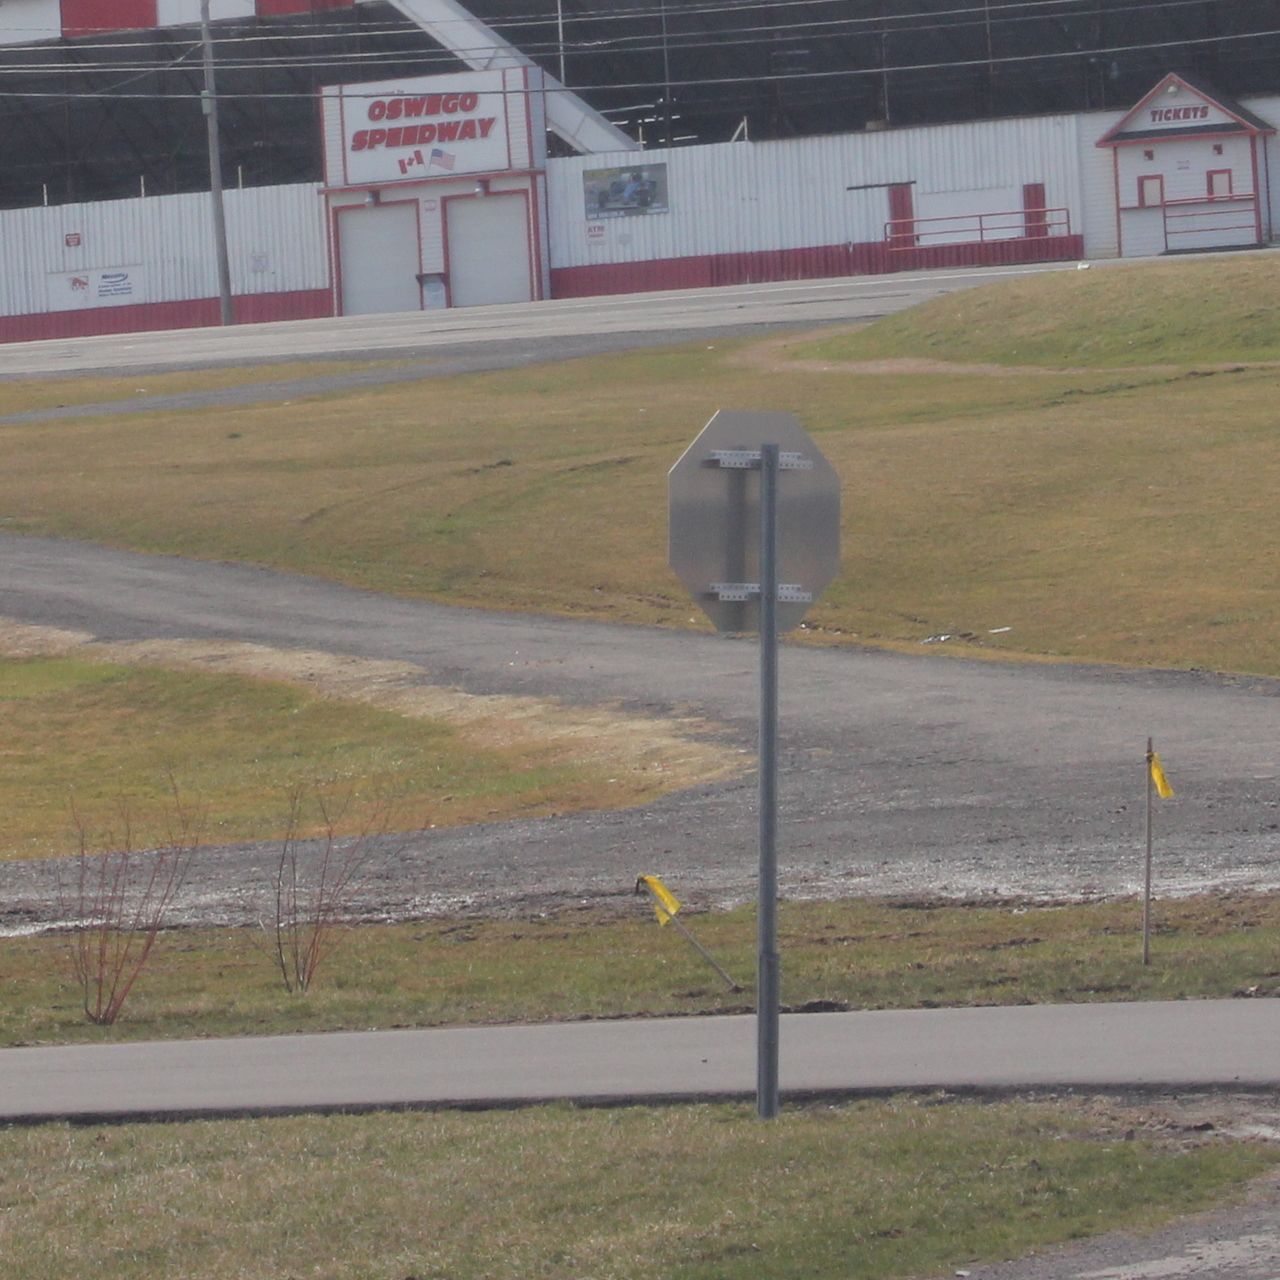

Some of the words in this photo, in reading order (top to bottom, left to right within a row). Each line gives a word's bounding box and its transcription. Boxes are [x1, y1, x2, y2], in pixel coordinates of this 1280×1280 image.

[367, 92, 478, 122] OSWEGO
[1150, 105, 1209, 122] TICKETS
[350, 117, 496, 151] SPEEDWAY
